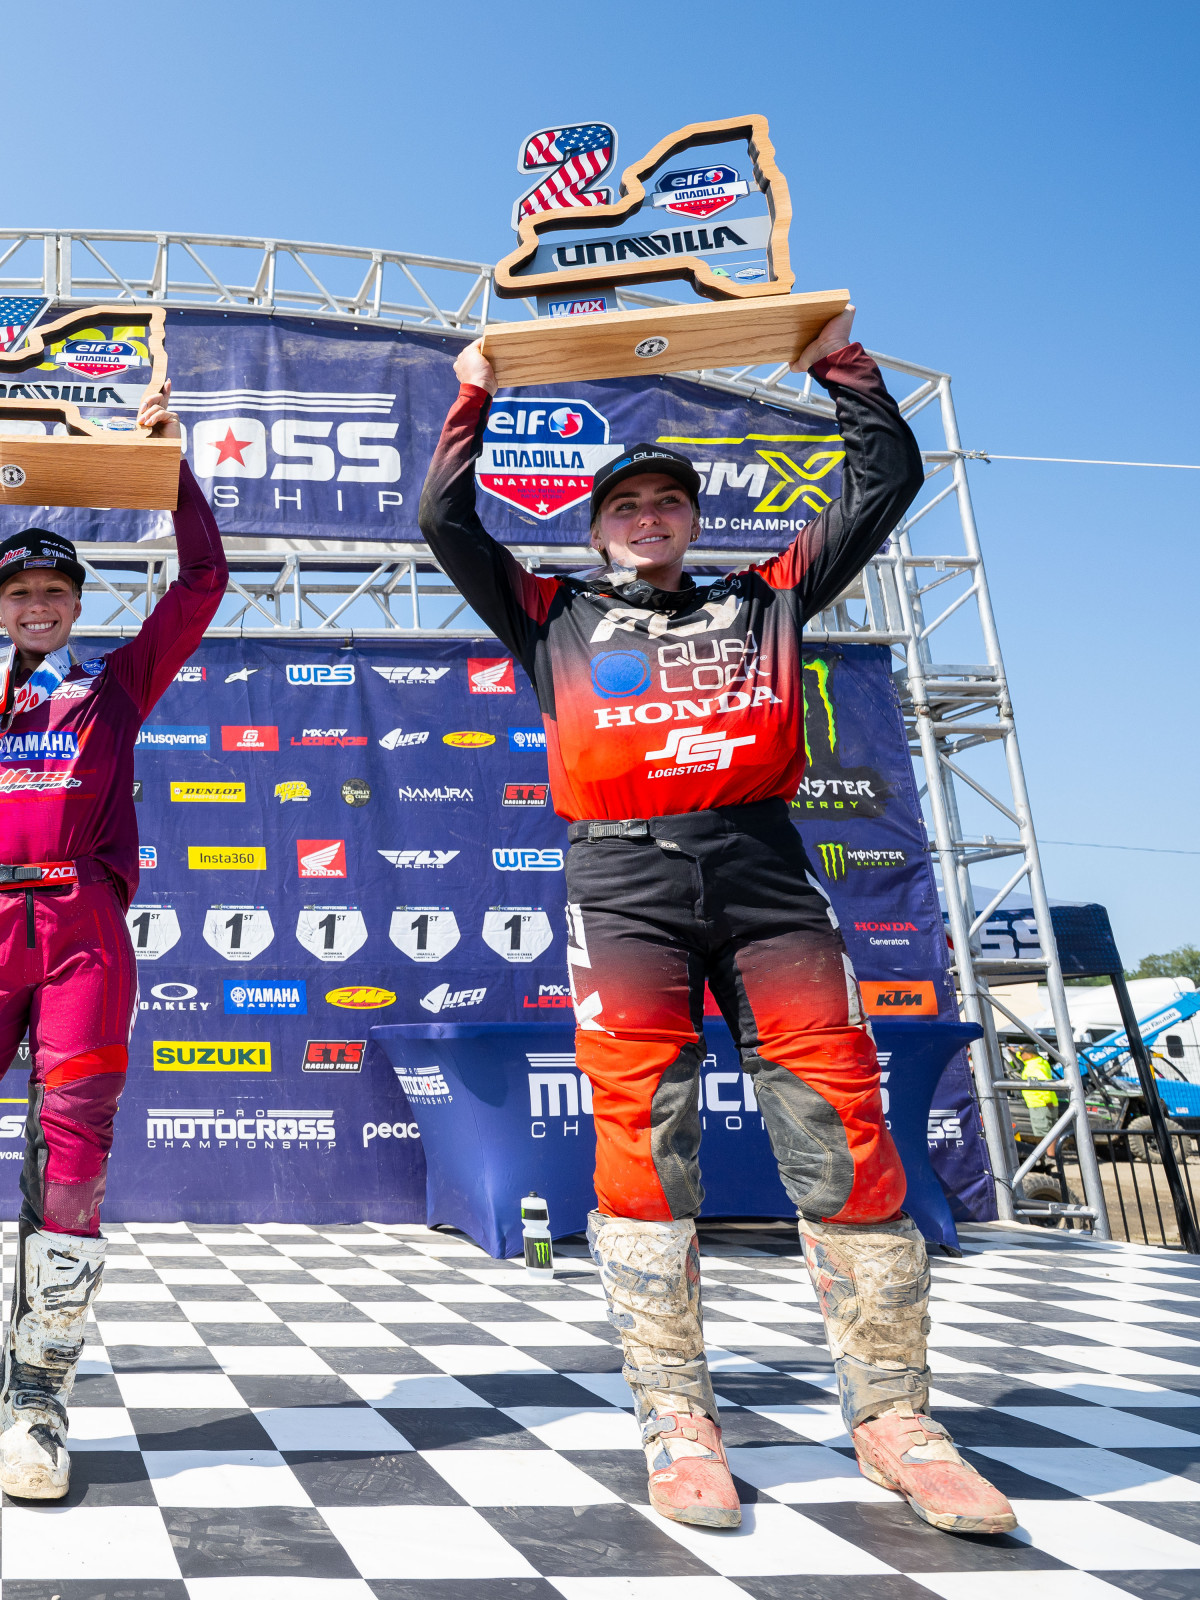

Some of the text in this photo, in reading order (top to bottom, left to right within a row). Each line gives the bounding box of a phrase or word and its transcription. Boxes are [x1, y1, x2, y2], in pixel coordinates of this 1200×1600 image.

[514, 121, 618, 231] 2
[671, 173, 703, 187] elf
[675, 187, 725, 200] UNADILLA
[676, 198, 727, 207] NATIONAL
[556, 225, 748, 267] UNADILLA
[551, 299, 606, 318] WMX
[76, 343, 106, 353] elf
[75, 354, 120, 363] UNADILLA
[487, 408, 546, 435] elf
[492, 449, 584, 469] UNADILLA
[494, 477, 589, 488] NATIONAL
[658, 631, 757, 667] QUAD
[286, 664, 355, 685] WPS
[594, 687, 782, 729] HONDA
[5, 731, 75, 753] YAMAHA
[142, 732, 206, 745] Husqvarna
[290, 736, 368, 748] LEGENDS
[399, 732, 429, 742] UFO
[443, 733, 496, 746] FMF
[647, 763, 715, 779] LOGISTICS
[276, 781, 308, 791] MOTO
[399, 786, 472, 799] NAMURA
[506, 786, 546, 799] ETS
[797, 776, 875, 797] NSTER
[279, 787, 311, 802] TEES
[200, 853, 254, 864] Insta360
[492, 849, 563, 871] WPS
[848, 850, 905, 861] MONSTER
[854, 922, 918, 931] HONDA
[870, 938, 909, 946] Generators
[247, 988, 299, 1003] YAMAHA
[326, 988, 396, 1007] FMF
[445, 988, 487, 1003] UFO
[876, 990, 922, 1006] KTM
[140, 1002, 210, 1011] OAKLEY
[157, 1048, 266, 1065] SUZUKI
[307, 1043, 363, 1062] ETS
[217, 1109, 265, 1117] PRO
[147, 1118, 336, 1140] MOTOCROSS
[362, 1122, 420, 1148] peac
[147, 1140, 337, 1149] CHAMPIONSHIP
